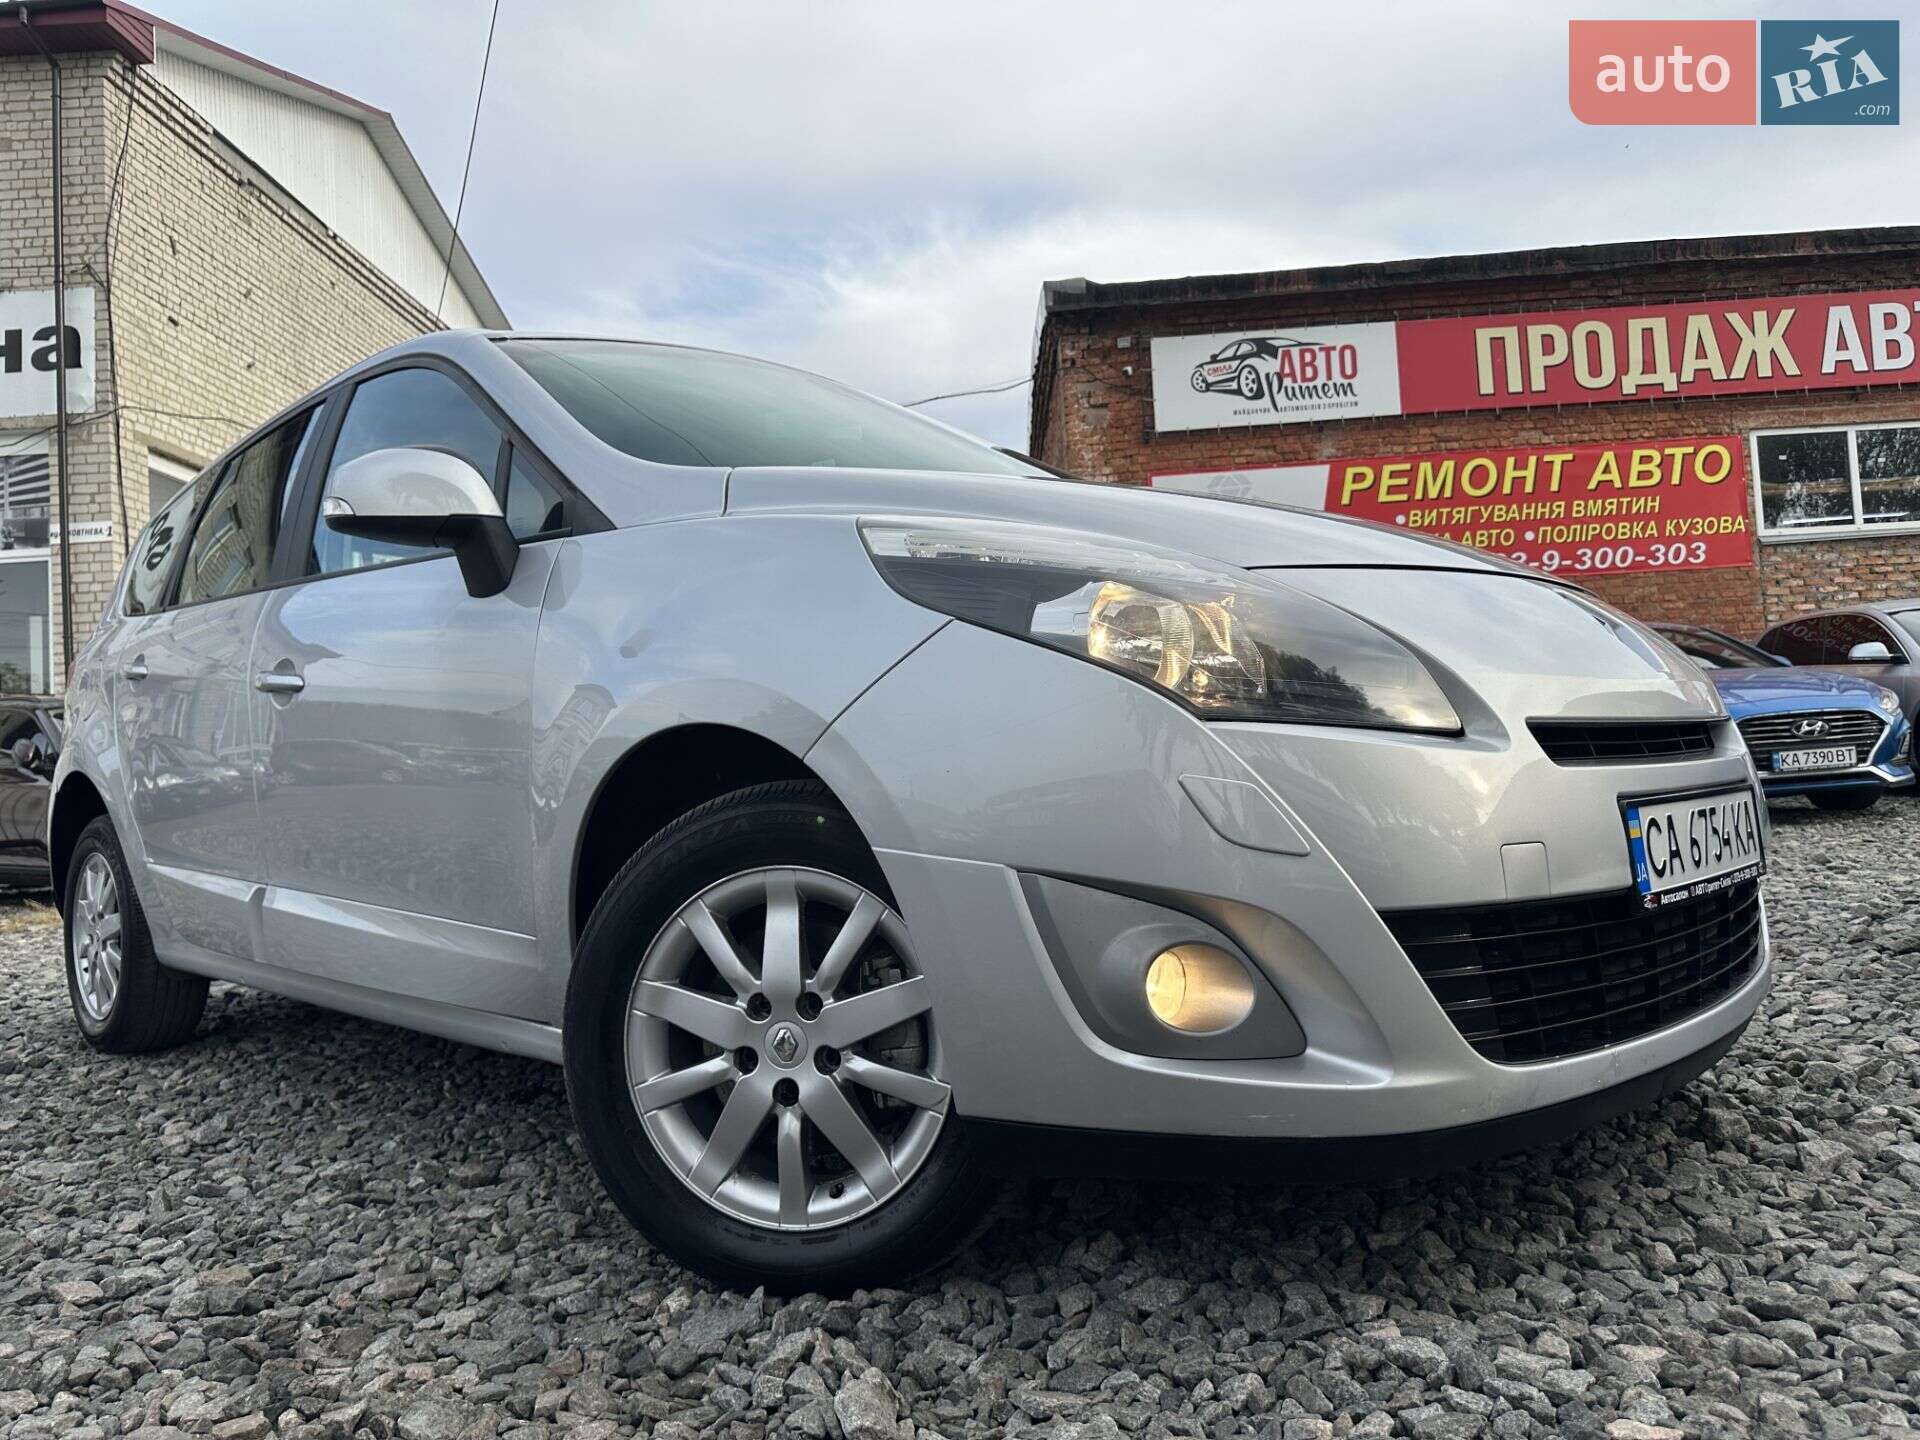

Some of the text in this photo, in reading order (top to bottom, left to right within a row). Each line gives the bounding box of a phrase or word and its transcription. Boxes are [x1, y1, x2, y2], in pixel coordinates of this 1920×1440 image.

[1278, 344, 1358, 384] АВТО
[1474, 300, 1920, 396] ПРОДАЖ АВ
[1340, 444, 1733, 506] РЕМОНТ АВТО
[1408, 496, 1661, 528] ВИТЯГУВАННЯ ВМЯТИН
[1537, 515, 1746, 544] ПОЛІРОВКА КУЗОВА
[1461, 528, 1515, 547] АВТО
